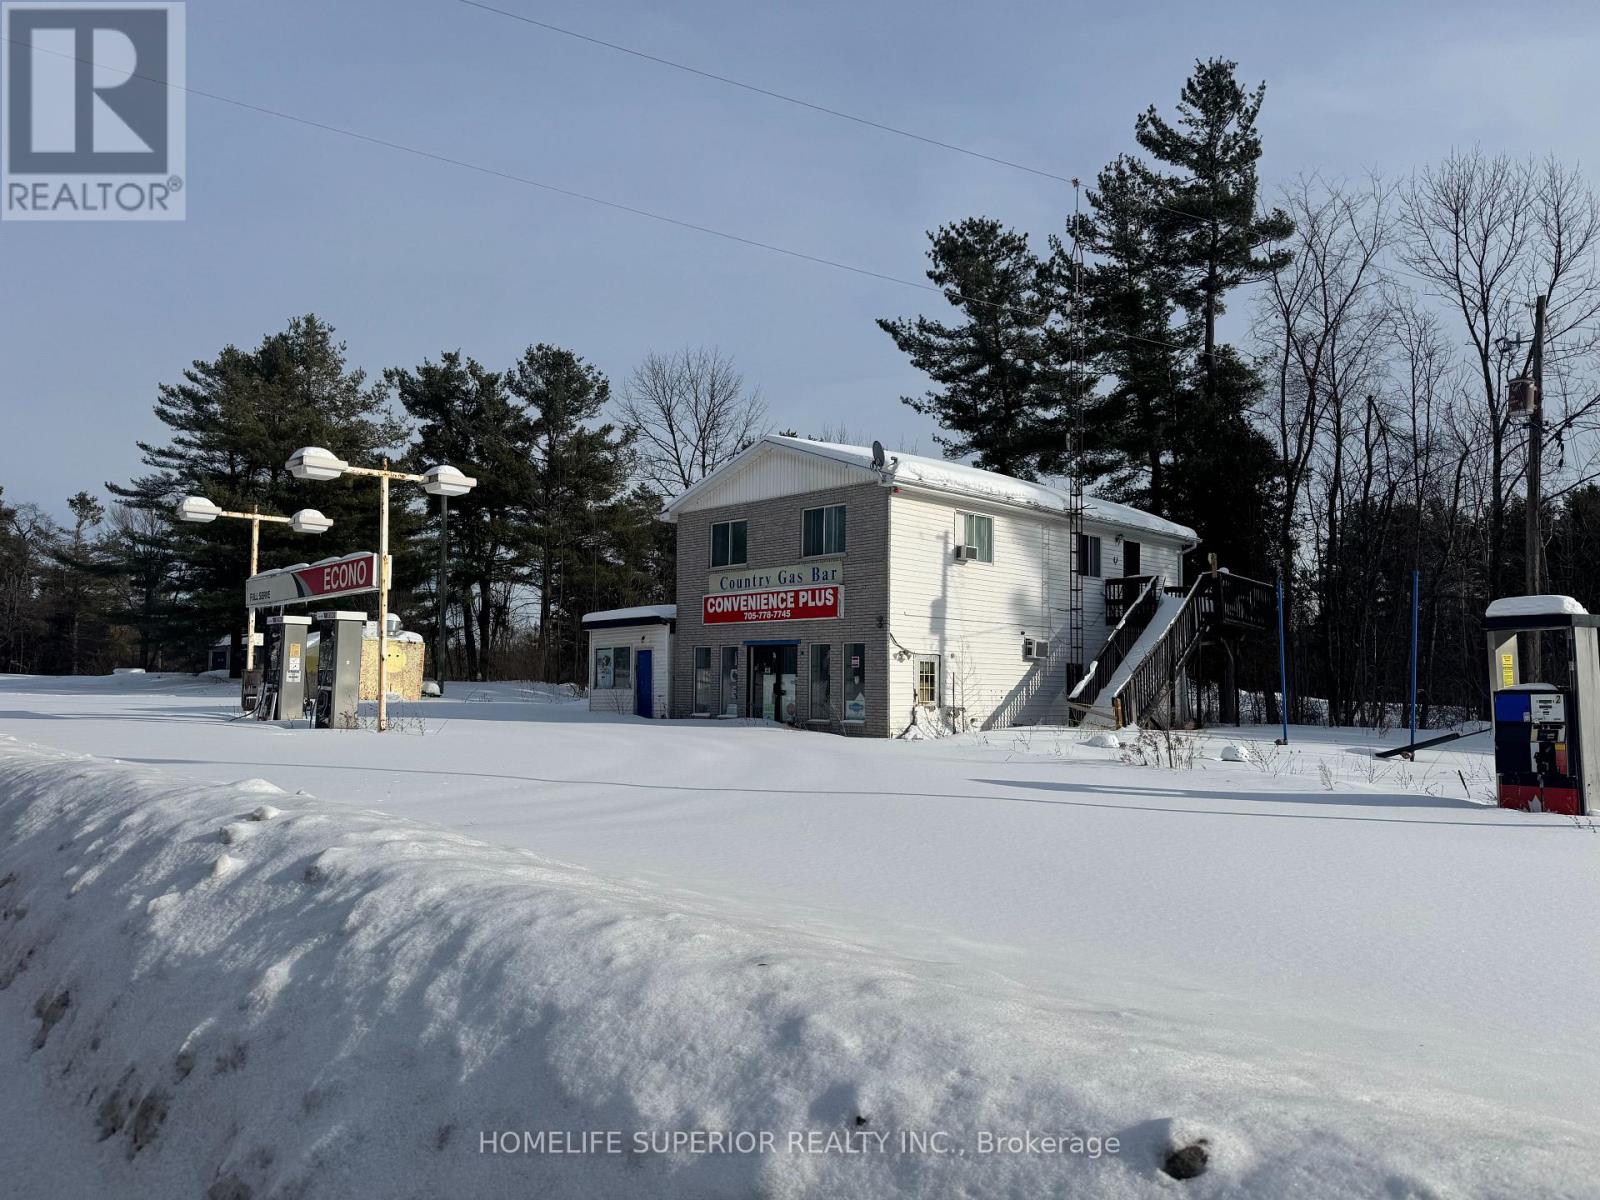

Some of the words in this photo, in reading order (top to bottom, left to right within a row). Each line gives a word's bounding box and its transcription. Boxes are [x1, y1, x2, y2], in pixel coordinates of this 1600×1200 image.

[323, 560, 367, 590] ECONO
[720, 575, 771, 590] Country
[778, 570, 803, 585] Gas
[812, 567, 837, 582] Bar
[707, 591, 795, 613] CONVENIENCE
[799, 589, 834, 607] PLUS
[743, 610, 791, 620] 705-778-7745
[1555, 695, 1561, 704] 2
